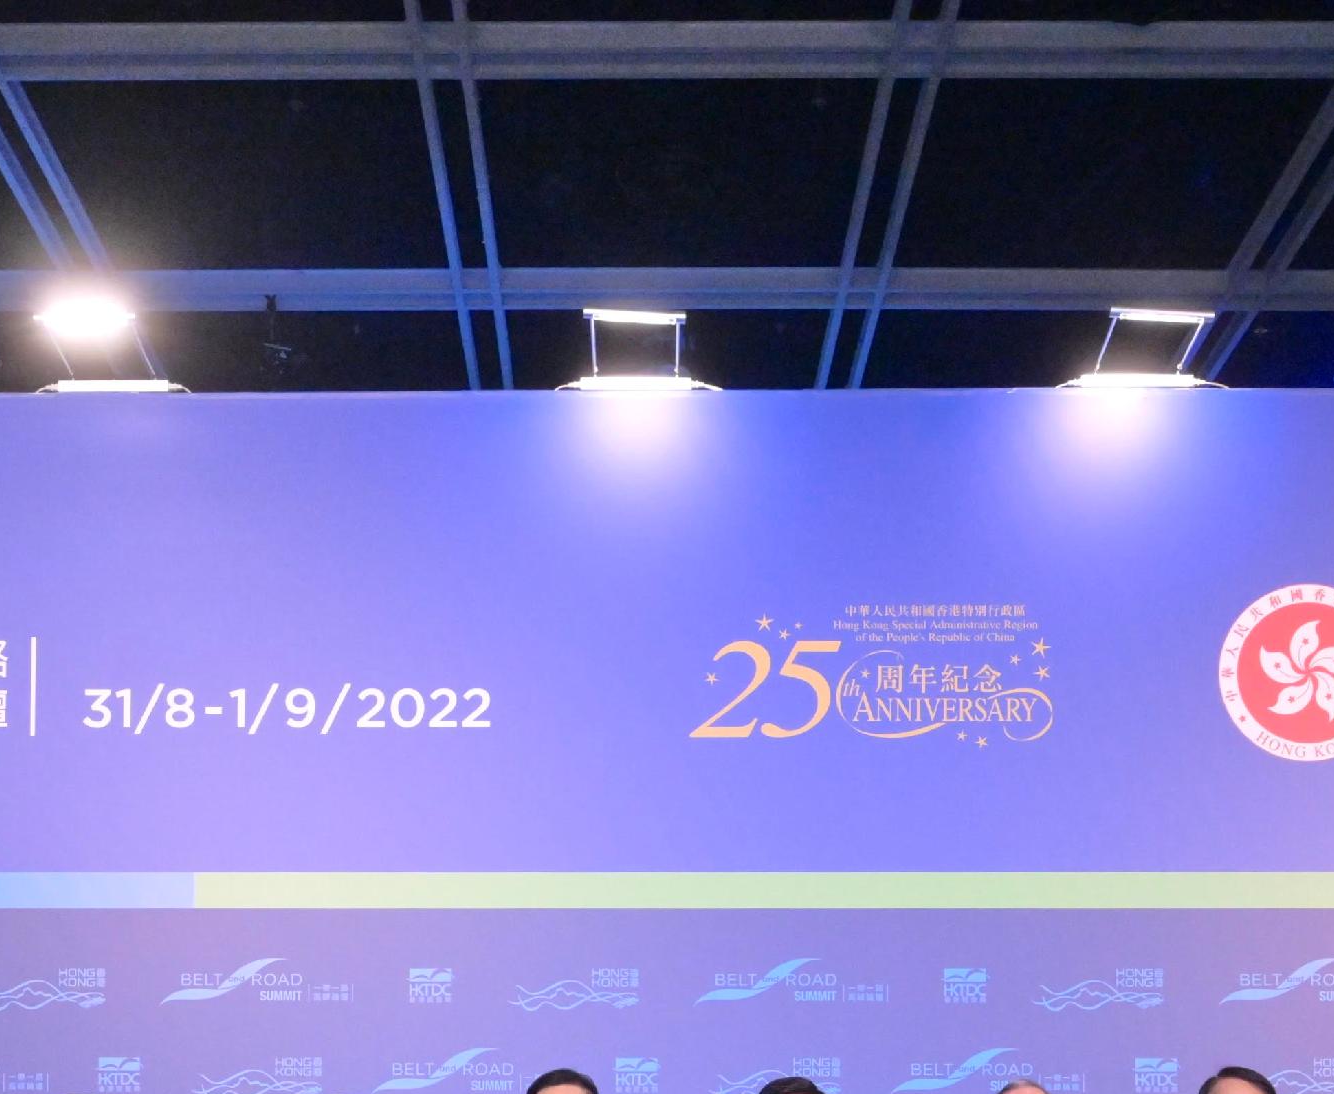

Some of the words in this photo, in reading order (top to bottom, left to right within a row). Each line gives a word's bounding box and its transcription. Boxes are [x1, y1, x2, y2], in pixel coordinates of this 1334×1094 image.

[891, 619, 927, 632] Special
[1004, 619, 1038, 632] Region
[875, 663, 1003, 694] 周年紀念
[851, 691, 1039, 723] ANNIVERSARY
[1255, 730, 1307, 758] HONG
[181, 974, 221, 986] BELT
[251, 974, 303, 986] ROAD
[715, 974, 756, 986] BELT
[785, 974, 837, 986] ROAD
[1240, 974, 1281, 986] BELT
[259, 991, 302, 1001] SUMMIT
[794, 991, 837, 1001] SUMMIT
[392, 1063, 433, 1075] BELT
[463, 1063, 513, 1075] ROAD
[911, 1064, 951, 1076] BELT
[982, 1064, 1033, 1076] ROAD
[471, 1080, 513, 1090] SUMMIT
